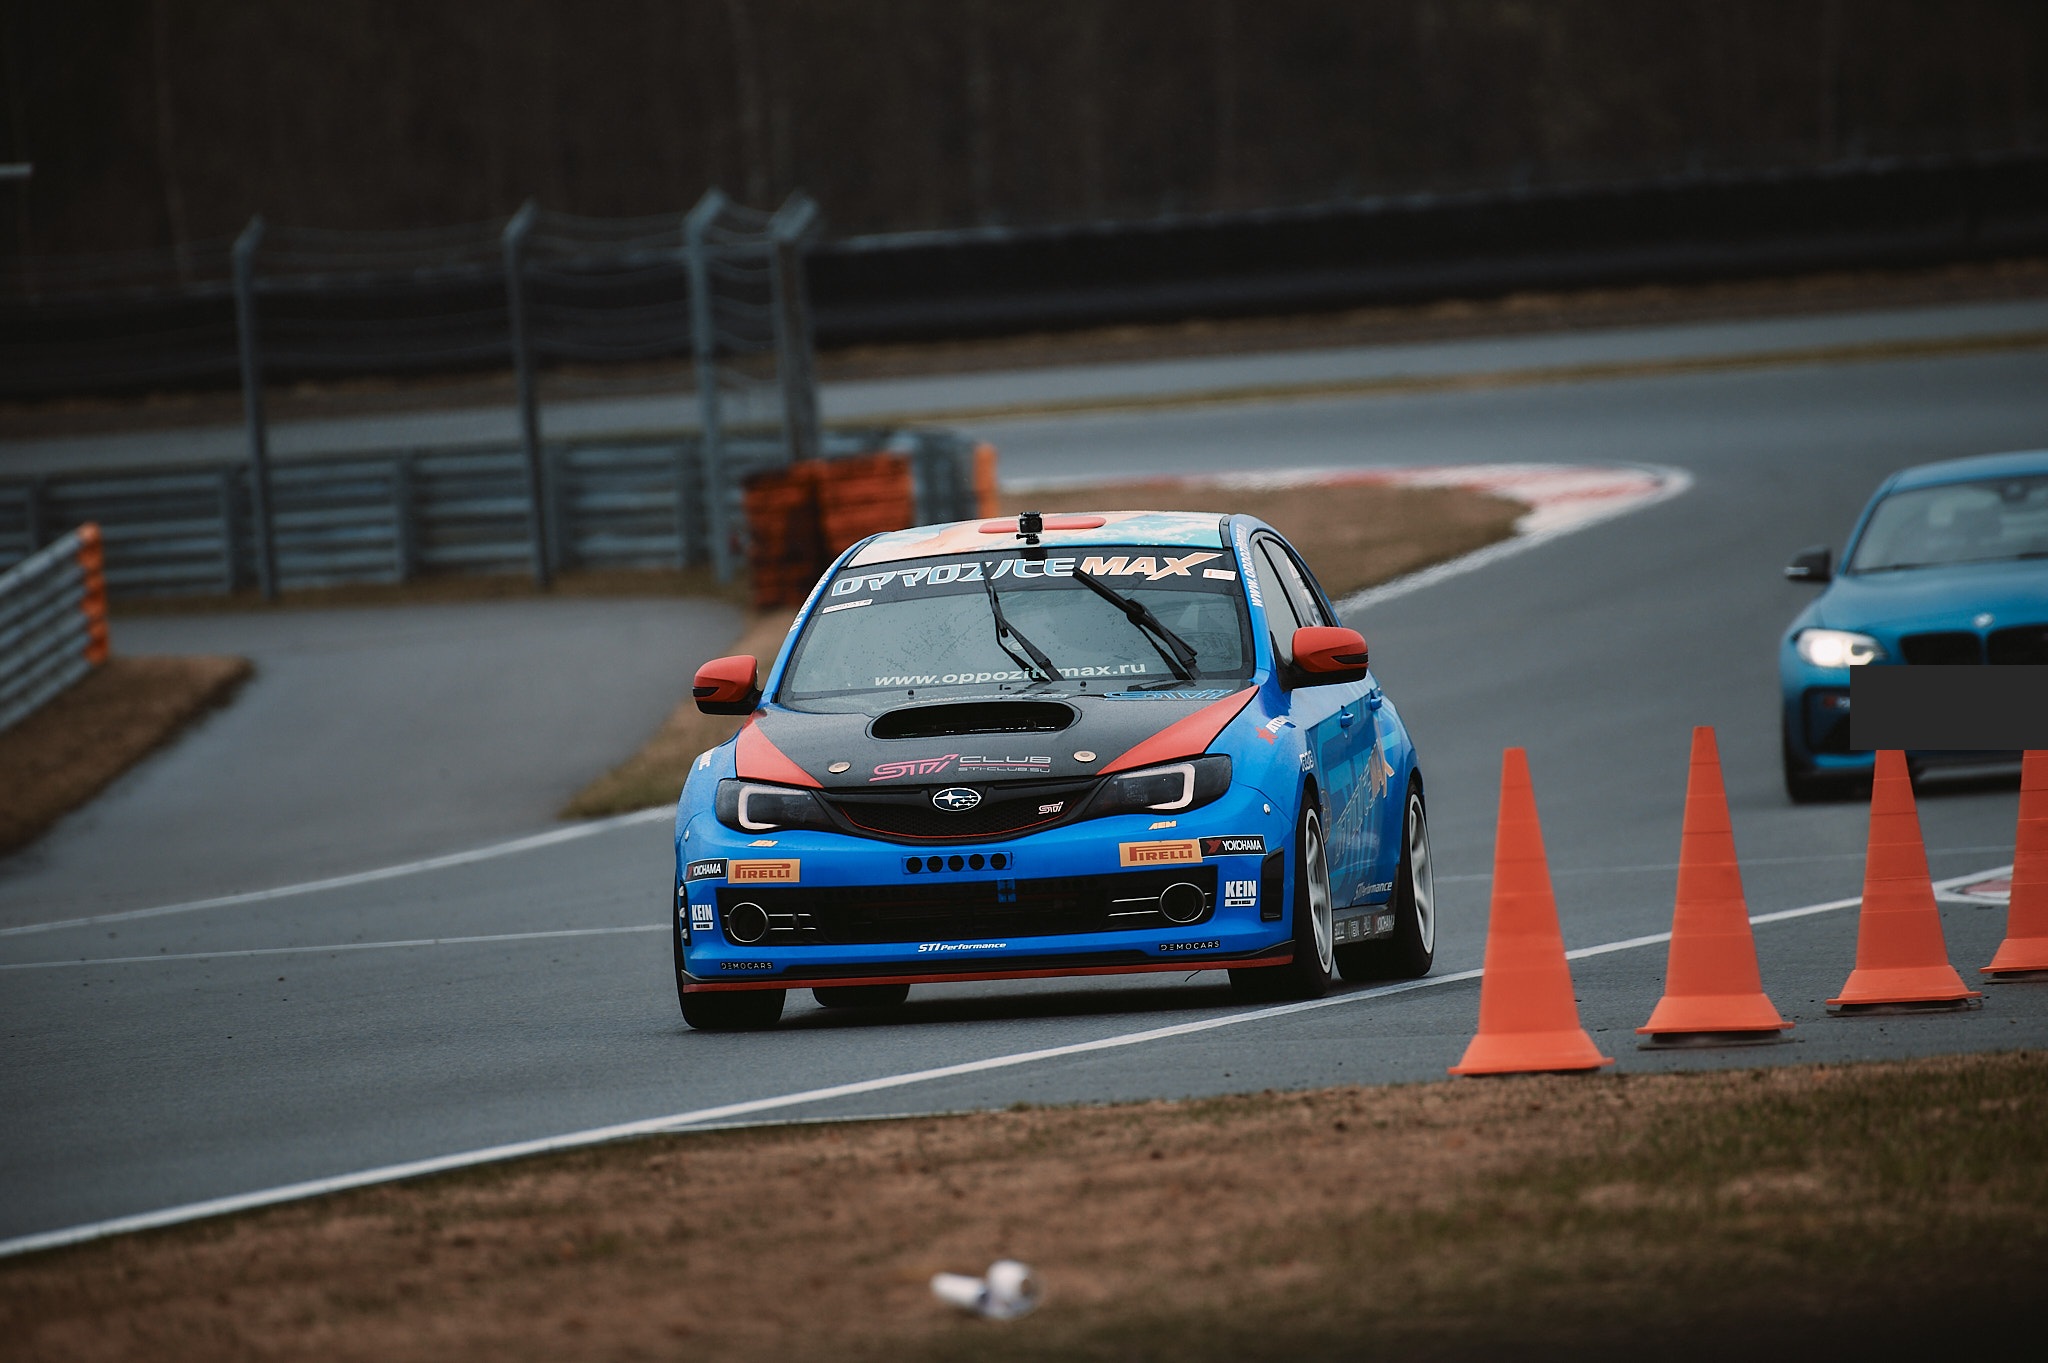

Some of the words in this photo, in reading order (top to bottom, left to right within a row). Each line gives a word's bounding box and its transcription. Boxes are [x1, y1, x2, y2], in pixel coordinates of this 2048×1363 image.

[1078, 551, 1223, 581] MAX
[959, 756, 1051, 764] CLUB
[1129, 843, 1193, 862] PIRELLI
[1221, 839, 1263, 852] YOKOHAMA
[735, 863, 791, 879] PIRELLI
[1225, 880, 1257, 897] KEIN
[691, 904, 714, 921] KEIN
[918, 942, 941, 953] STI
[941, 941, 1007, 951] Performance
[1159, 940, 1220, 952] DEMOCARS
[721, 962, 773, 970] DEMOCARS
